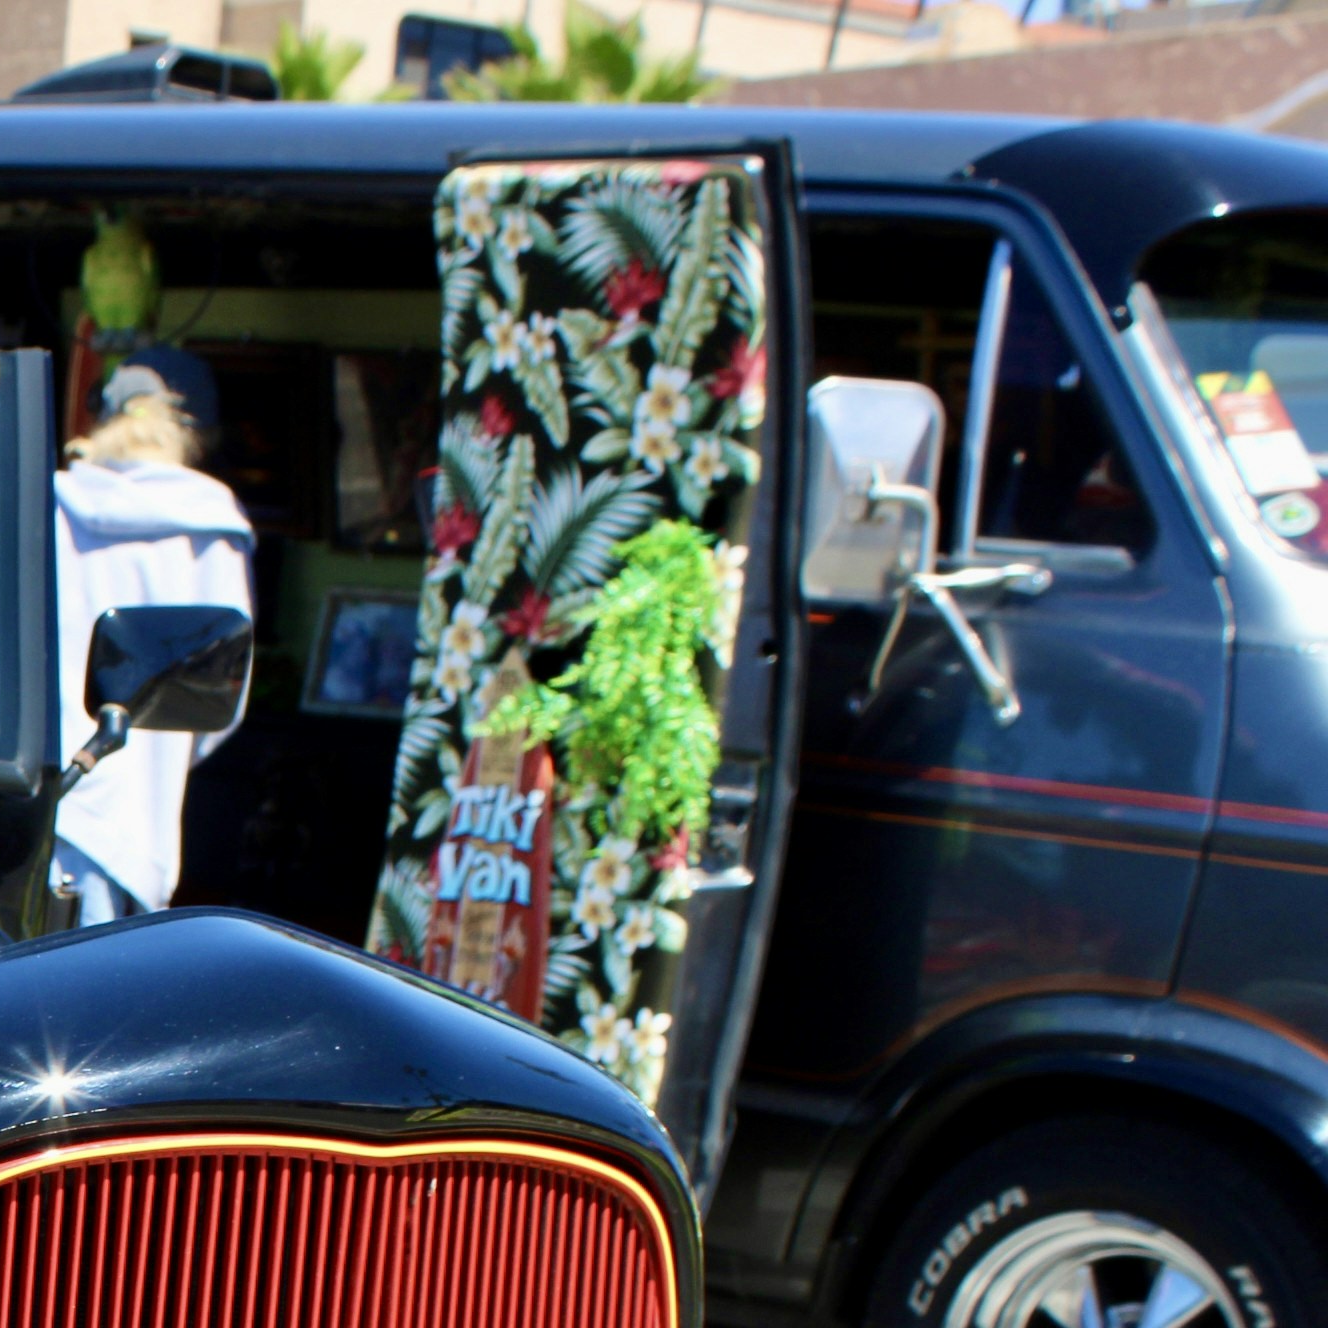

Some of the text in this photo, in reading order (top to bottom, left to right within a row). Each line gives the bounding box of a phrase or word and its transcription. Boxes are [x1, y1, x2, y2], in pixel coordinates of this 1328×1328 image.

[449, 783, 546, 852] Tiki
[436, 841, 531, 906] Van
[907, 1186, 1029, 1317] COBRA
